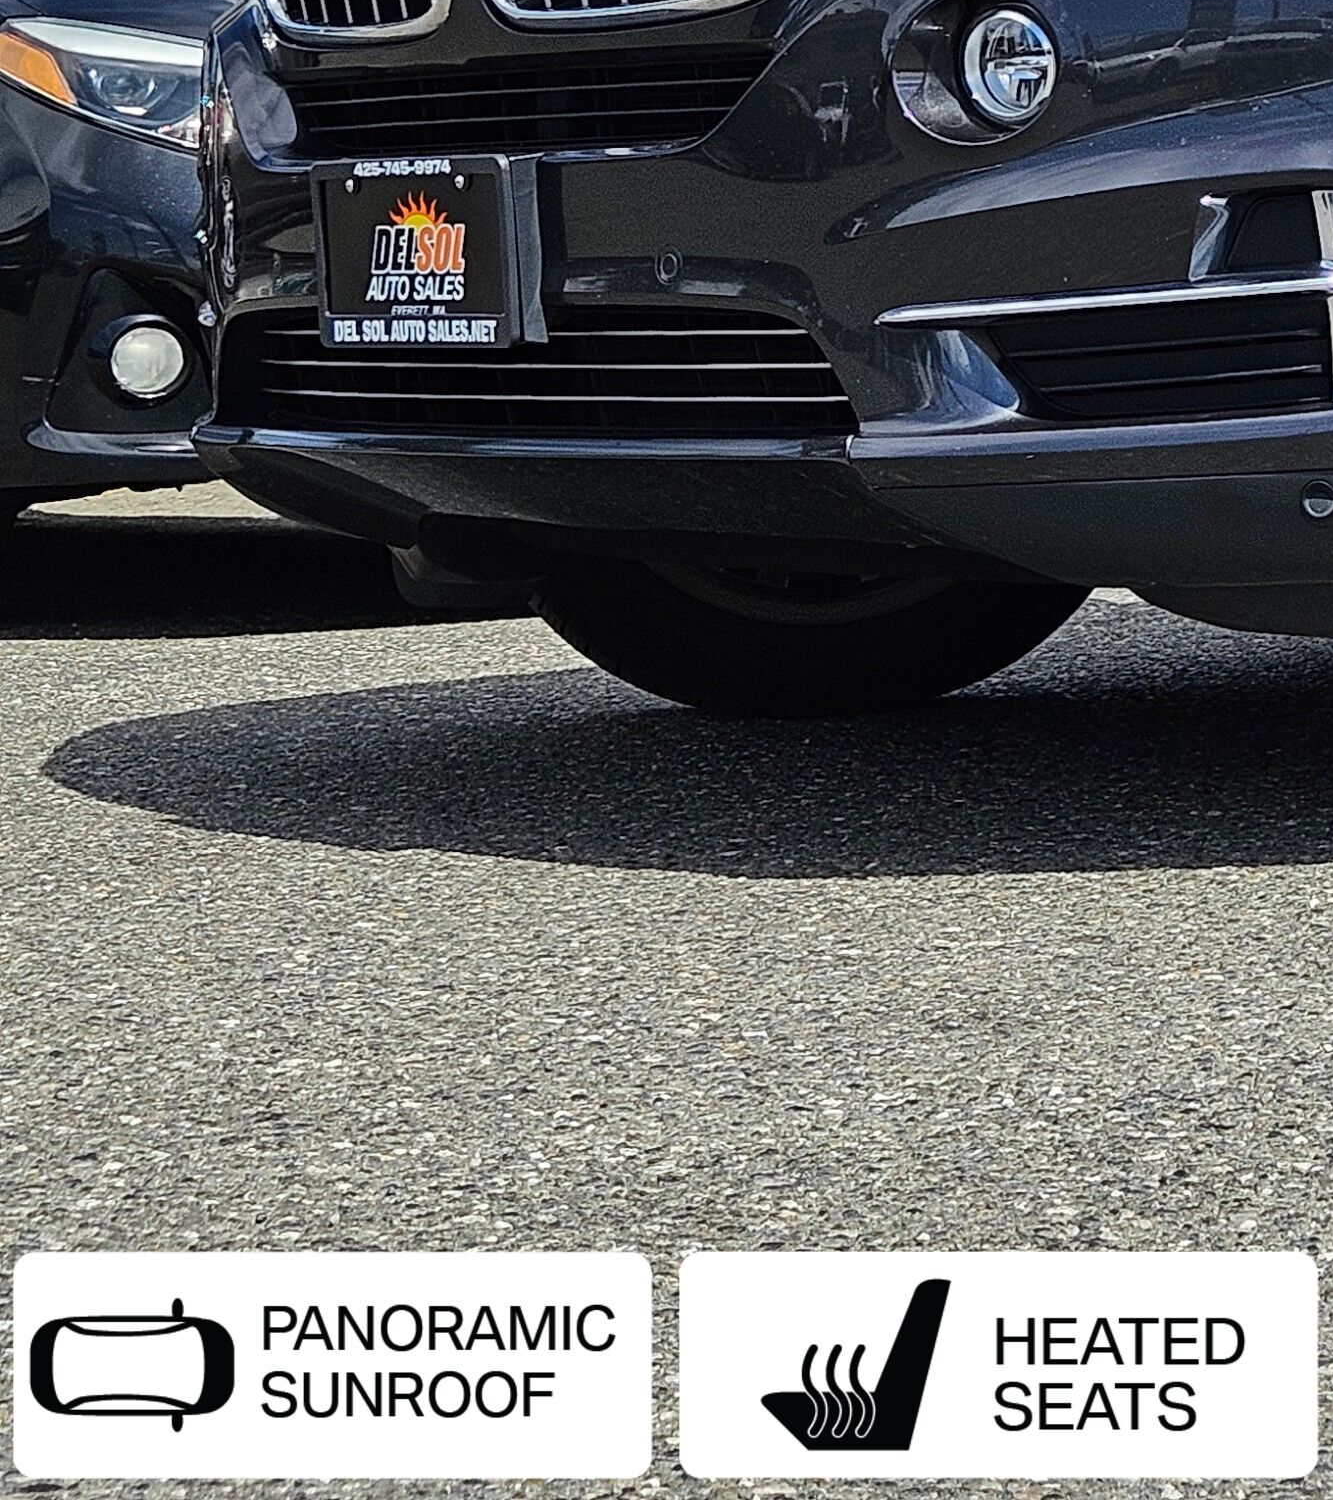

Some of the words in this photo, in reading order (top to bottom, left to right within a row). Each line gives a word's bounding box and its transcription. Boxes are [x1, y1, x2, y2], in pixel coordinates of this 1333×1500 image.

[353, 159, 452, 177] 425-745-9974
[365, 276, 410, 301] AUTO
[413, 275, 465, 301] SALES
[333, 320, 361, 343] DEL
[362, 320, 390, 343] SOL
[390, 320, 426, 343] AUTO
[427, 319, 498, 343] SALES.NET
